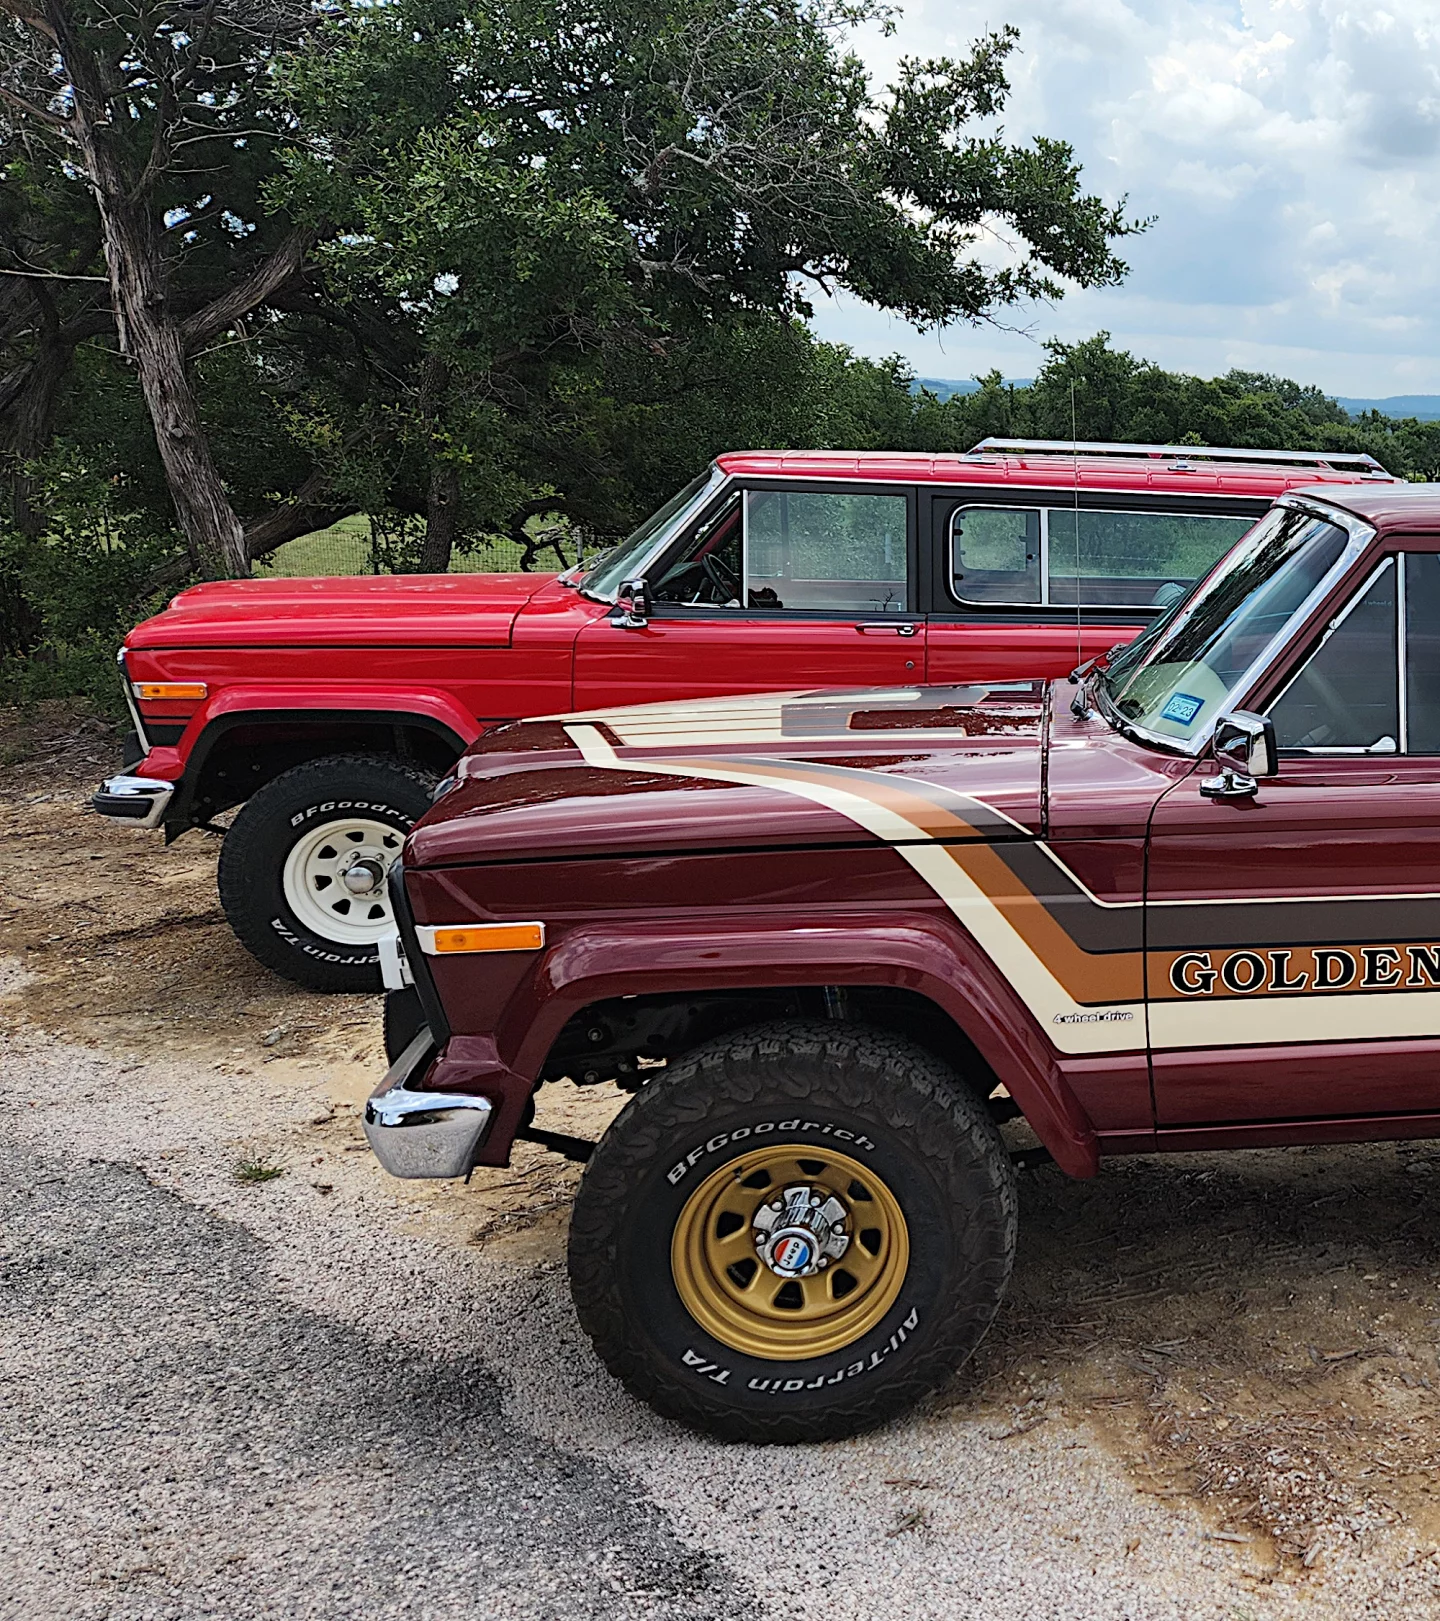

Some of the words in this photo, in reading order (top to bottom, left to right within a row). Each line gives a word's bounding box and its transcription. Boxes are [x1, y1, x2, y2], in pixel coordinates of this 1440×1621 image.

[291, 802, 416, 827] BFGoodric
[270, 918, 300, 946] T/A
[1053, 1013, 1062, 1024] 4
[1063, 1011, 1101, 1024] wheel
[1103, 1010, 1134, 1021] drive
[666, 1119, 877, 1186] BFGoodrich
[783, 1241, 800, 1265] Jeep
[746, 1307, 920, 1395] All-Terrain
[681, 1348, 733, 1386] T/A
